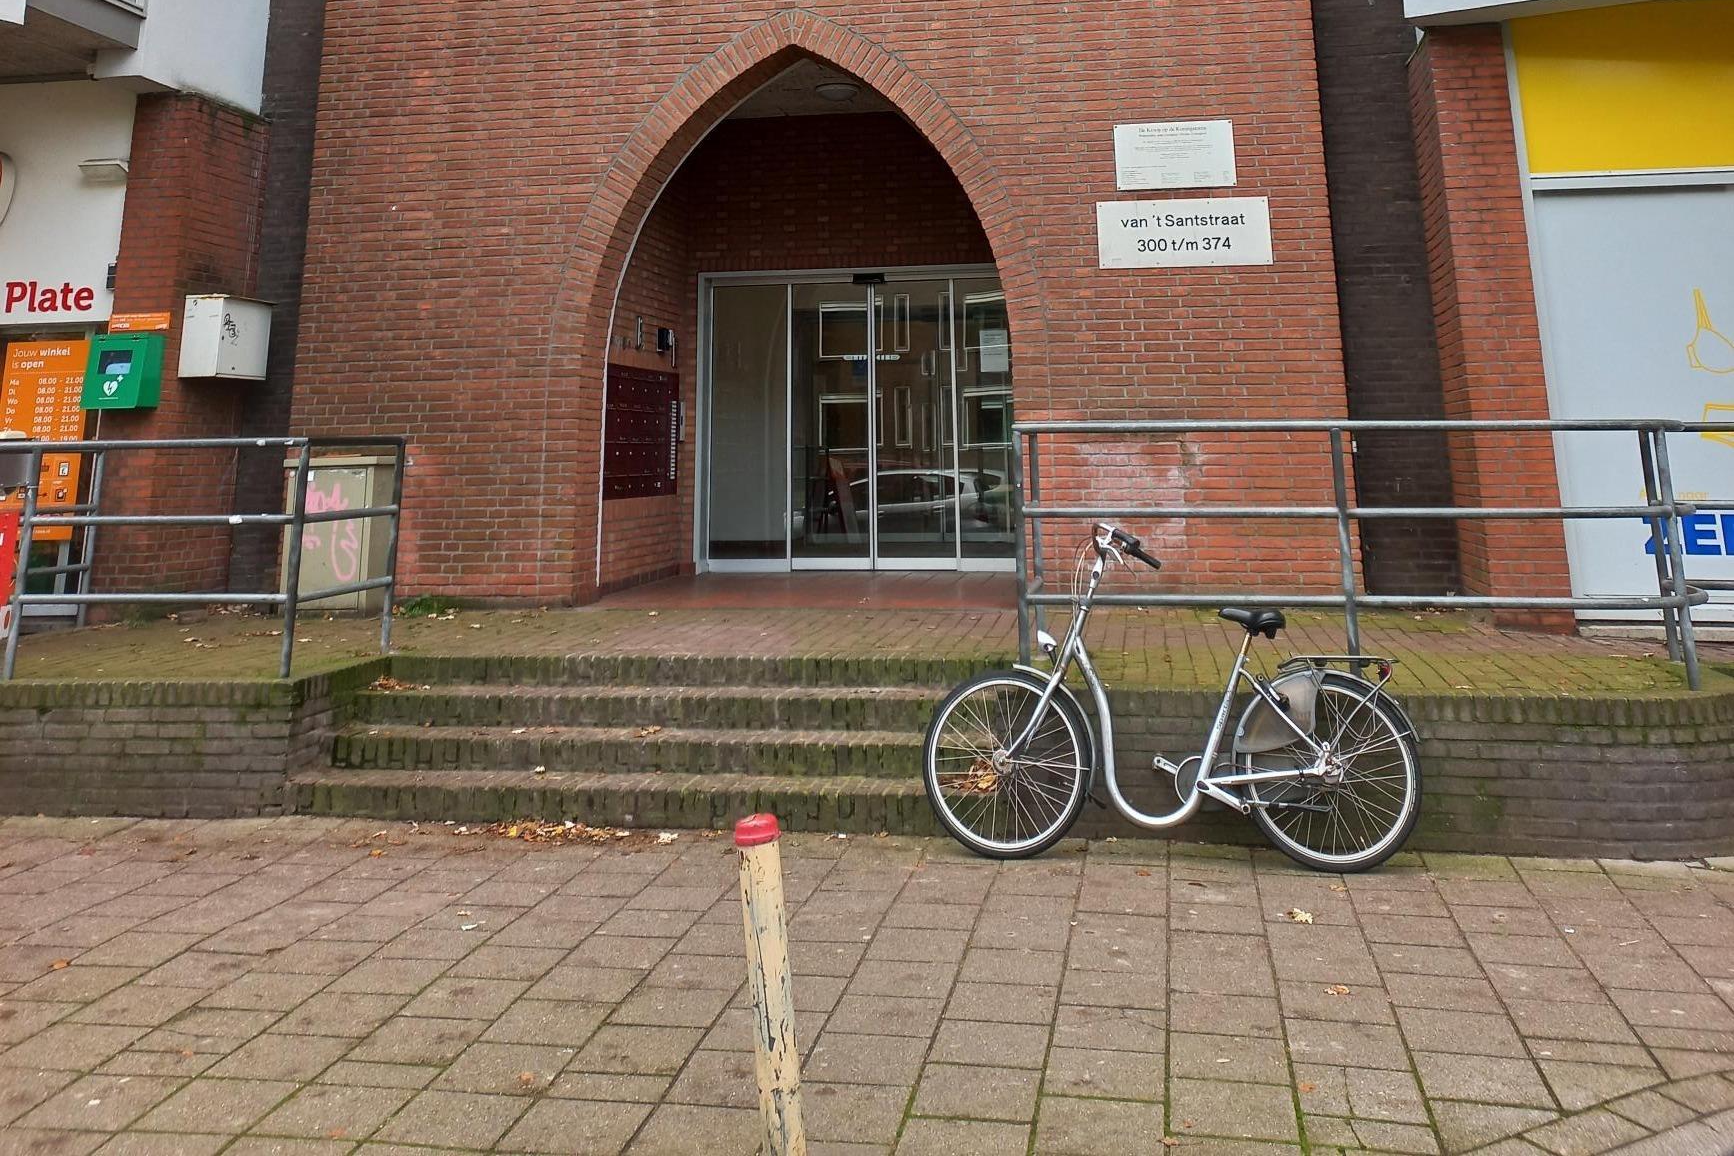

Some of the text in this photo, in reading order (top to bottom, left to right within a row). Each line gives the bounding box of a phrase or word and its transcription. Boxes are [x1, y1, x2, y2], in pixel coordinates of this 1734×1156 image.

[1120, 213, 1246, 228] van 't Santstraat
[1137, 237, 1232, 252] 300 t/m 374
[5, 281, 94, 313] Plate
[13, 347, 71, 358] Jouw winkel
[11, 360, 45, 370] is open
